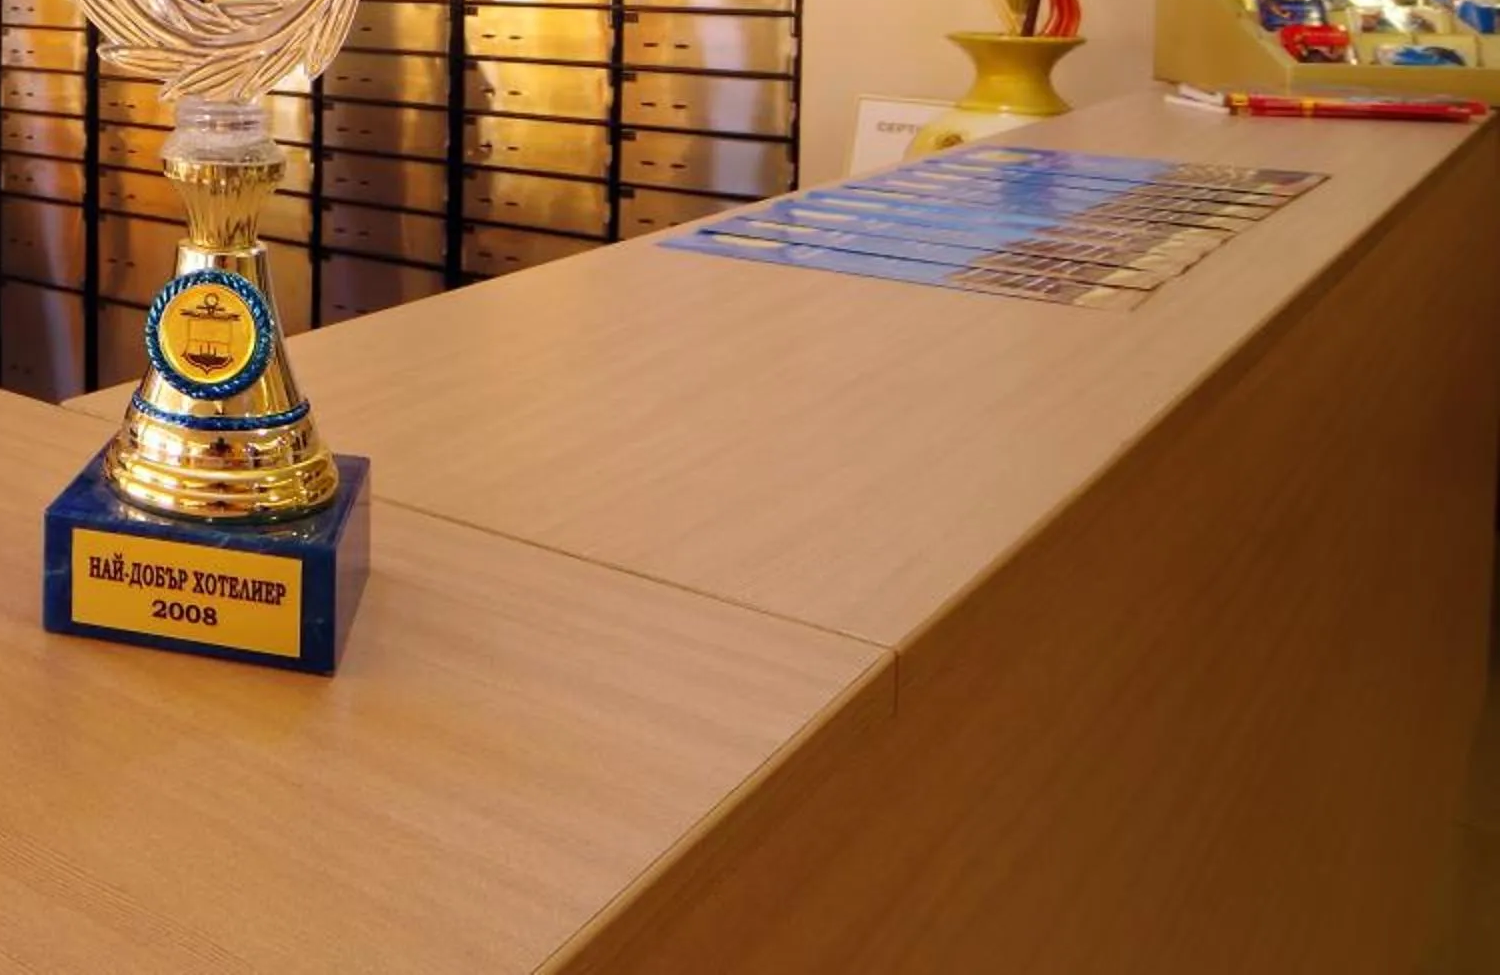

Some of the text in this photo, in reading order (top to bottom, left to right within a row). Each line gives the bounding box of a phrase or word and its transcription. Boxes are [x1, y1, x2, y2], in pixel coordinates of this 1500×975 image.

[89, 553, 287, 606] НАЙ-ДОБЪР ХОТЕЛИЕР
[152, 600, 218, 626] 2008
